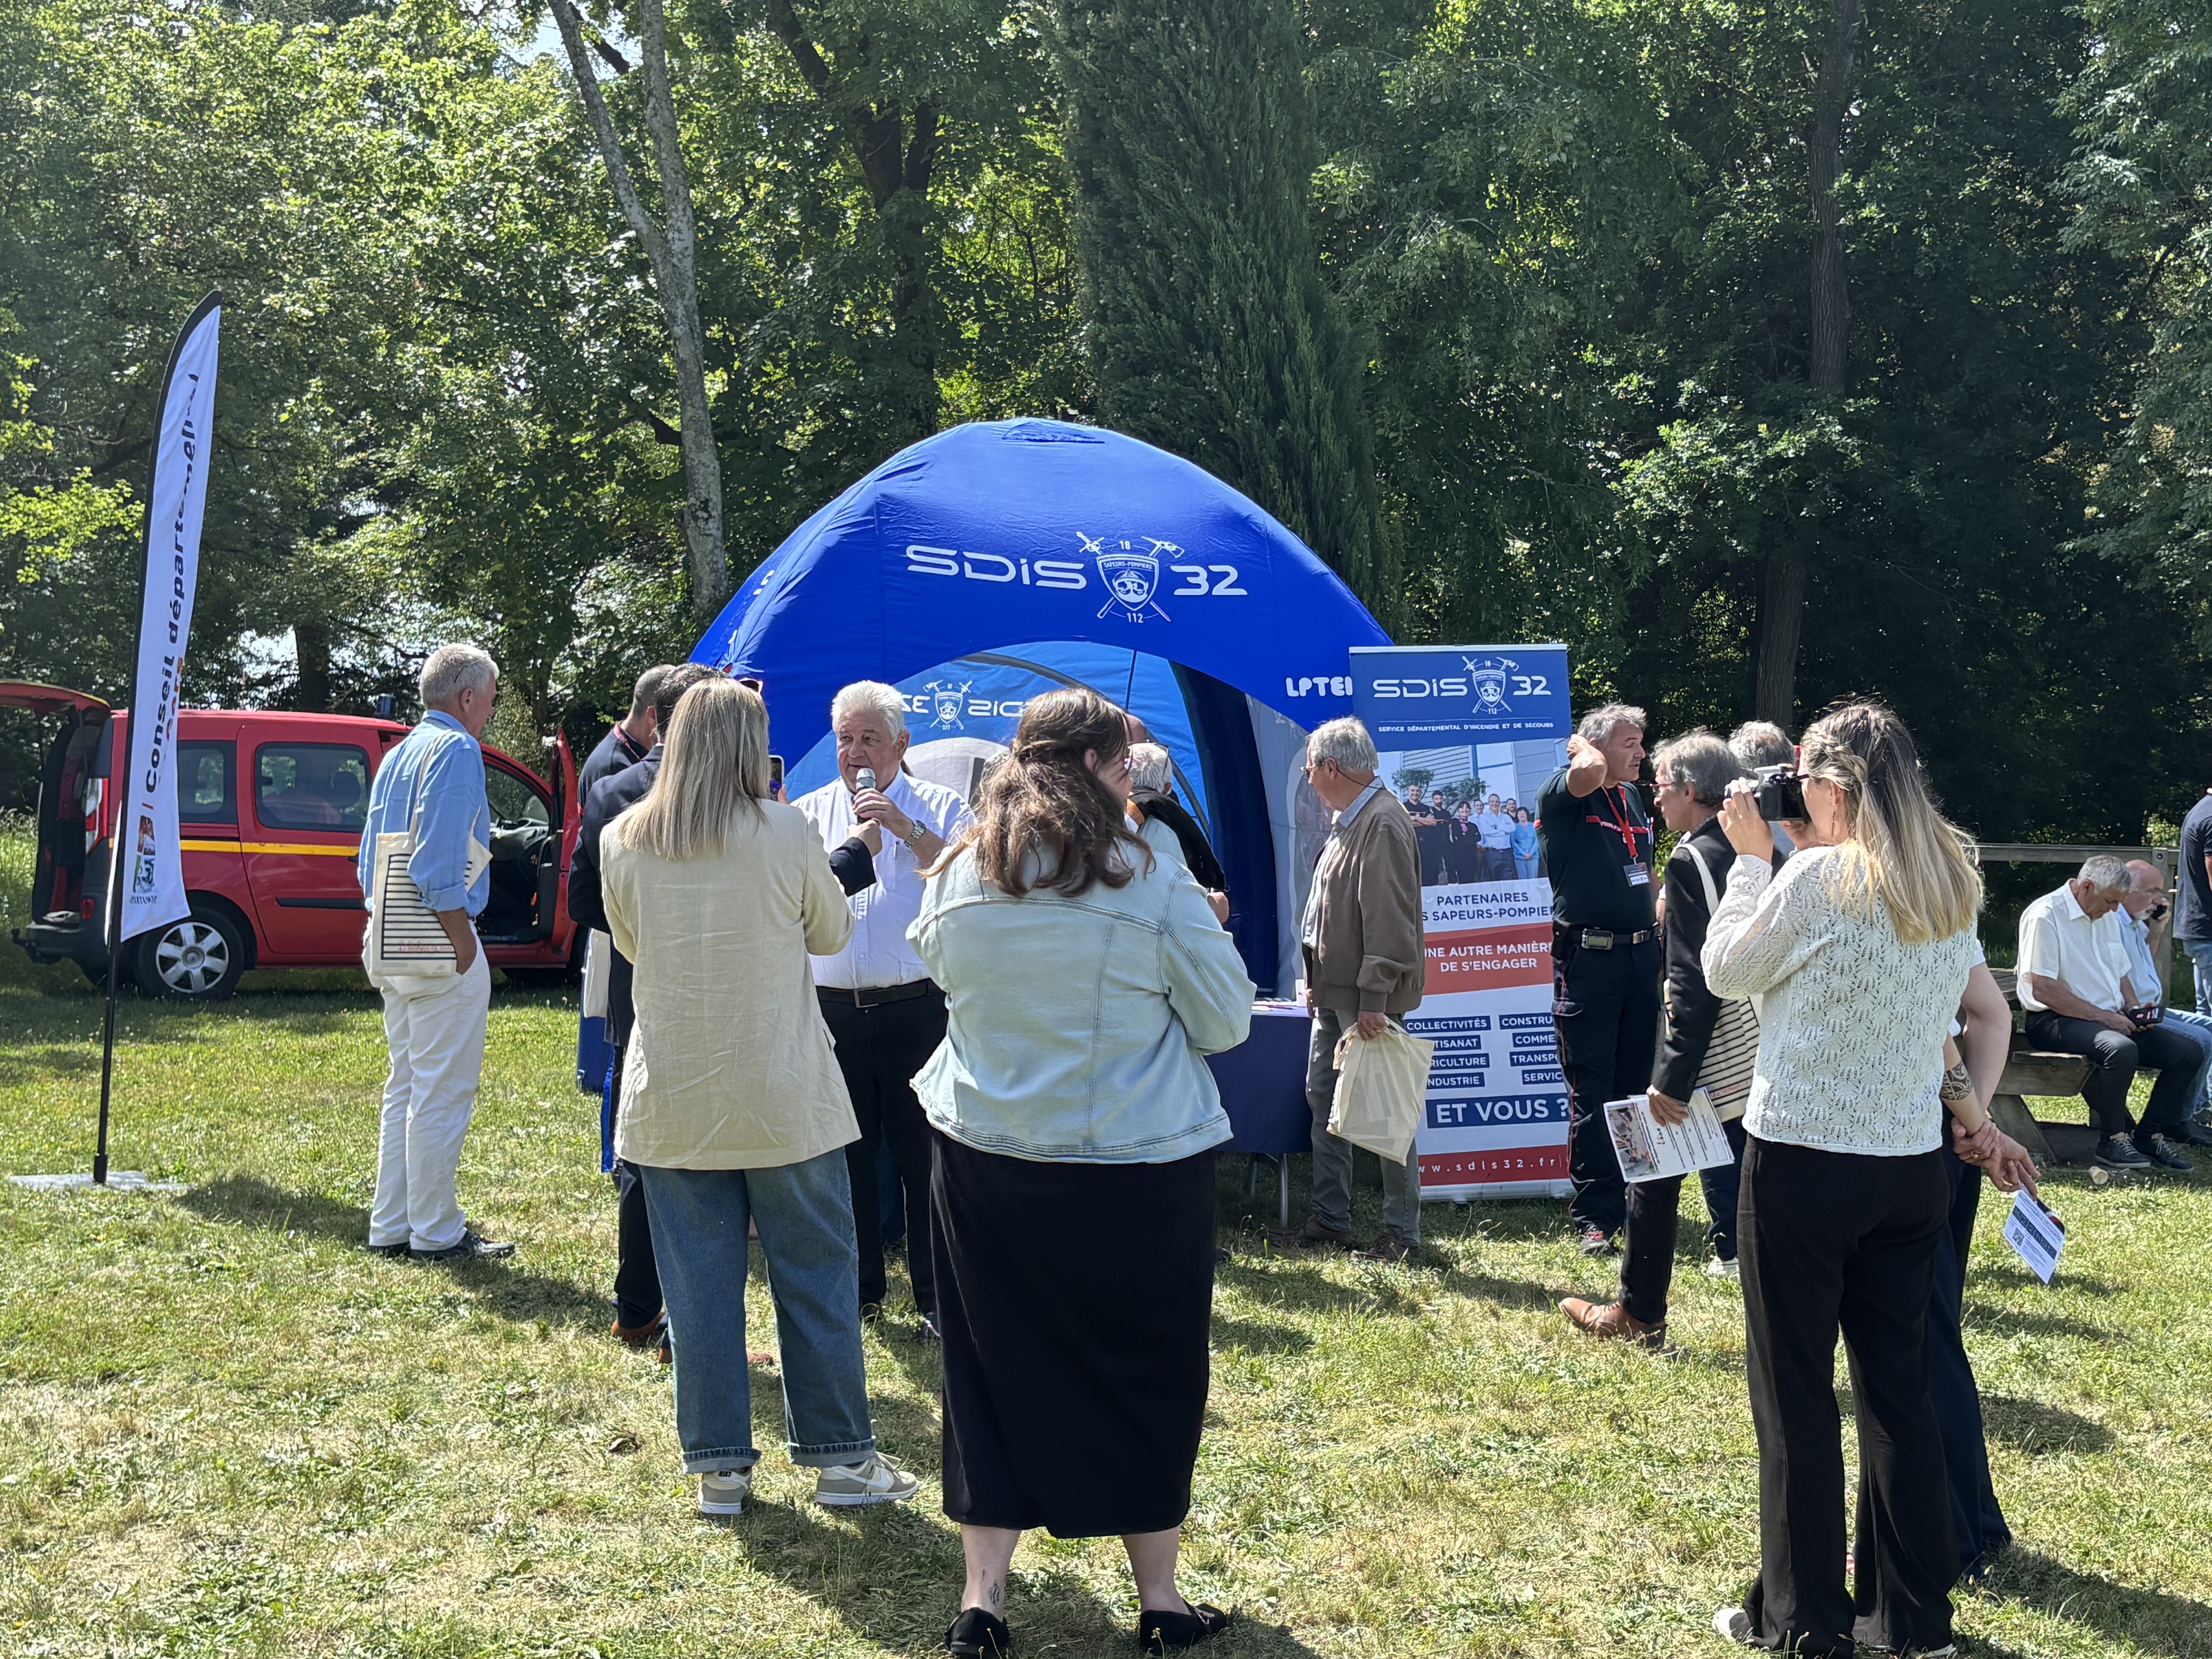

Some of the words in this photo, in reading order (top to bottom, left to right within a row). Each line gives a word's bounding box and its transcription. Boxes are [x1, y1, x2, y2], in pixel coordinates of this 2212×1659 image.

[1119, 541, 1131, 550] 18
[1170, 565, 1248, 596] 32
[1126, 612, 1144, 623] 112
[1511, 675, 1552, 696] 32
[146, 655, 175, 793] Conseil
[1437, 892, 1529, 906] PARTENAIRES
[1449, 945, 1493, 957] AUTRE
[1440, 962, 1458, 972] DE
[1462, 958, 1537, 971] S'ENGAGER
[1407, 1018, 1487, 1030] COLLECTIVITÉS
[1502, 1016, 1553, 1026] CONSTRU
[1434, 1039, 1478, 1048] TISANAT
[1515, 1034, 1556, 1044] COMME
[1431, 1057, 1487, 1067] RICULTURE
[1427, 1076, 1480, 1086] NDUSTRIE
[1524, 1072, 1563, 1082] SERVIC
[1436, 1103, 1467, 1123] ET
[1474, 1099, 1549, 1121] VOUS
[1556, 1098, 1569, 1117] ?
